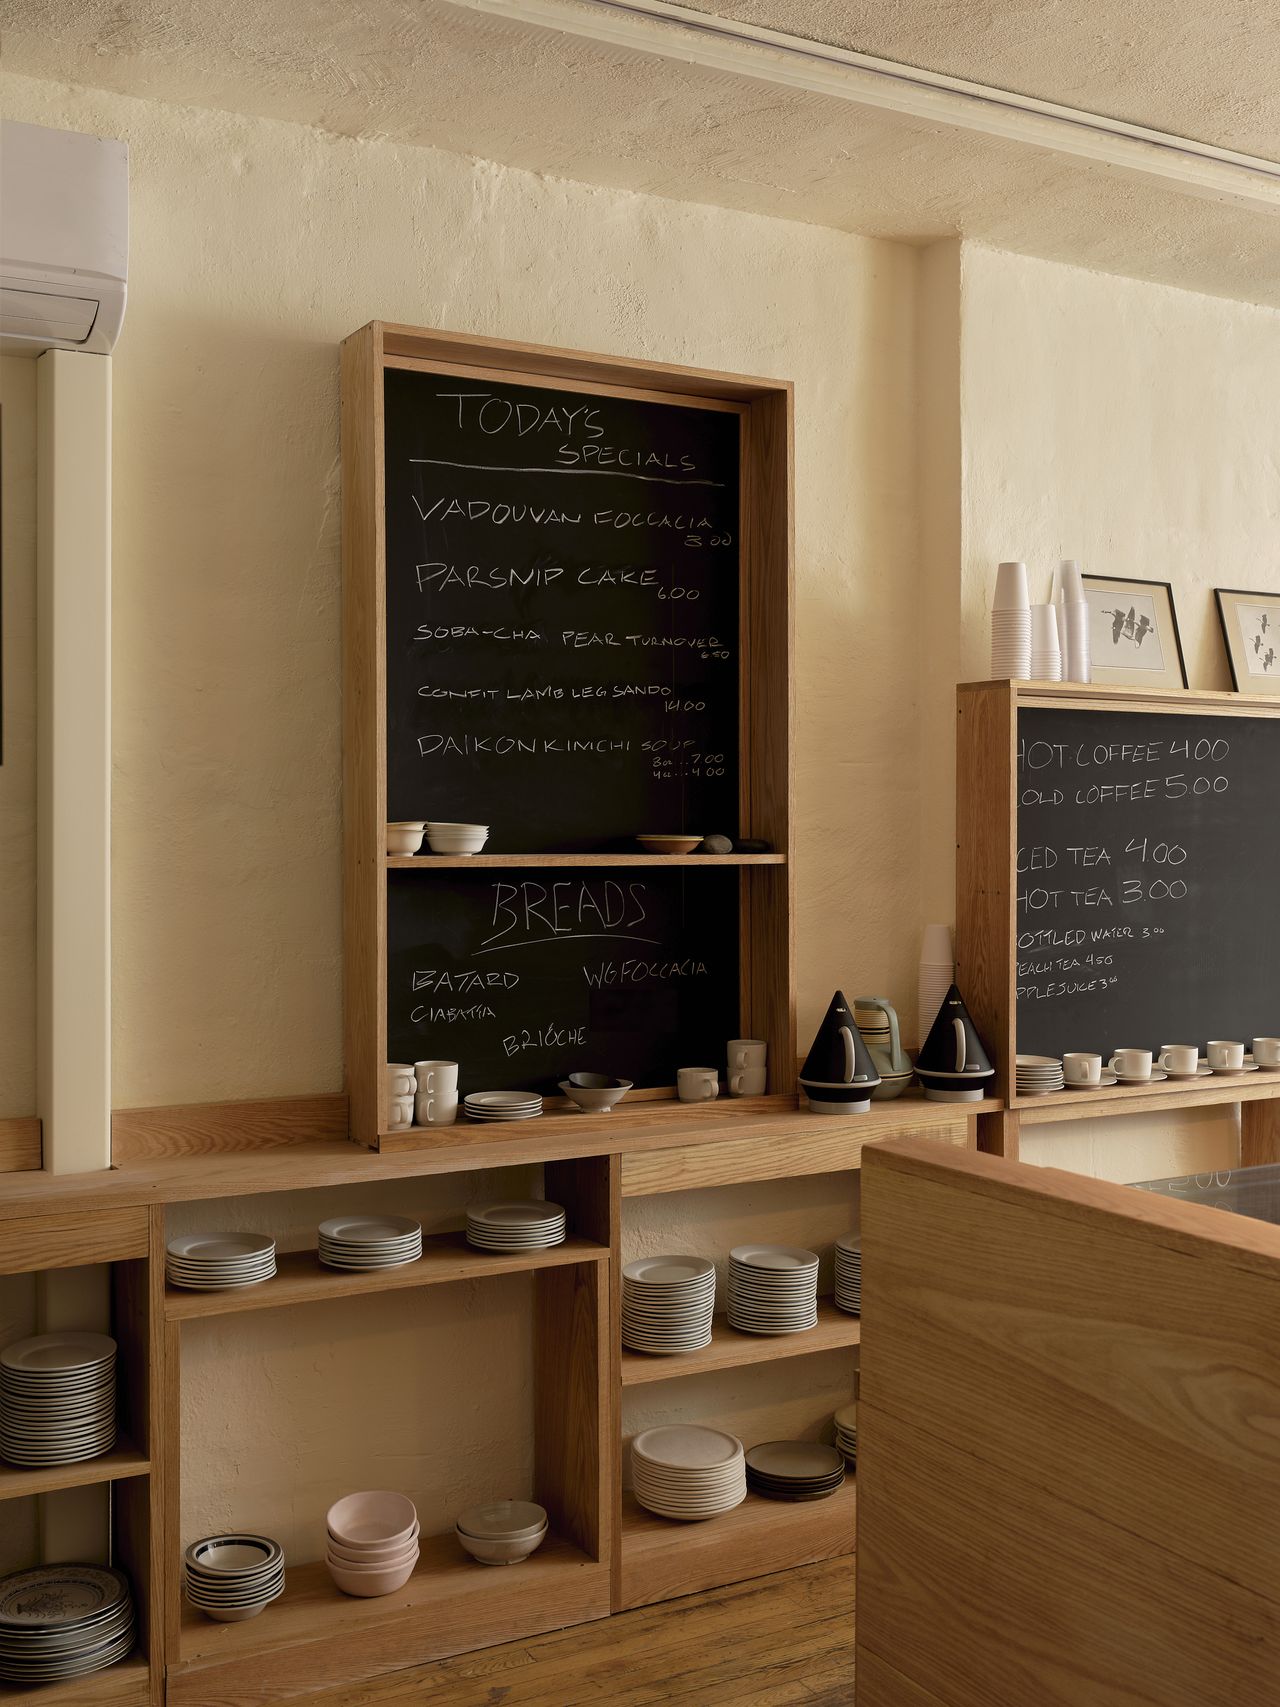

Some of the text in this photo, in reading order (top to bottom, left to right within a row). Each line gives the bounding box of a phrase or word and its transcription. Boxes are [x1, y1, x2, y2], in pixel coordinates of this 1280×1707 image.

[436, 393, 604, 439] TODAY'S
[555, 443, 696, 471] SPECIALS
[411, 495, 582, 524] VADOUVAN
[415, 562, 660, 592] PARSNIP CAKE
[413, 624, 725, 648] SOBA-CHA PEAR TURNOVER
[418, 685, 672, 701] CONFIT LAMB LEG SANDO
[417, 733, 537, 758] DAIKON
[544, 738, 632, 753] KIMCHI
[1075, 741, 1164, 767] COFFEE
[1017, 789, 1064, 808] OLD
[1075, 778, 1161, 804] COFFEE
[1016, 846, 1058, 873] CED
[1066, 846, 1112, 867] TEA
[1070, 886, 1113, 907] TEA
[480, 880, 647, 946] BREADS
[1015, 929, 1087, 949] OTTLED
[1090, 926, 1135, 943] WATER
[1056, 957, 1081, 971] TEA
[412, 969, 521, 993] BATARD
[1015, 982, 1056, 1000] PPLE
